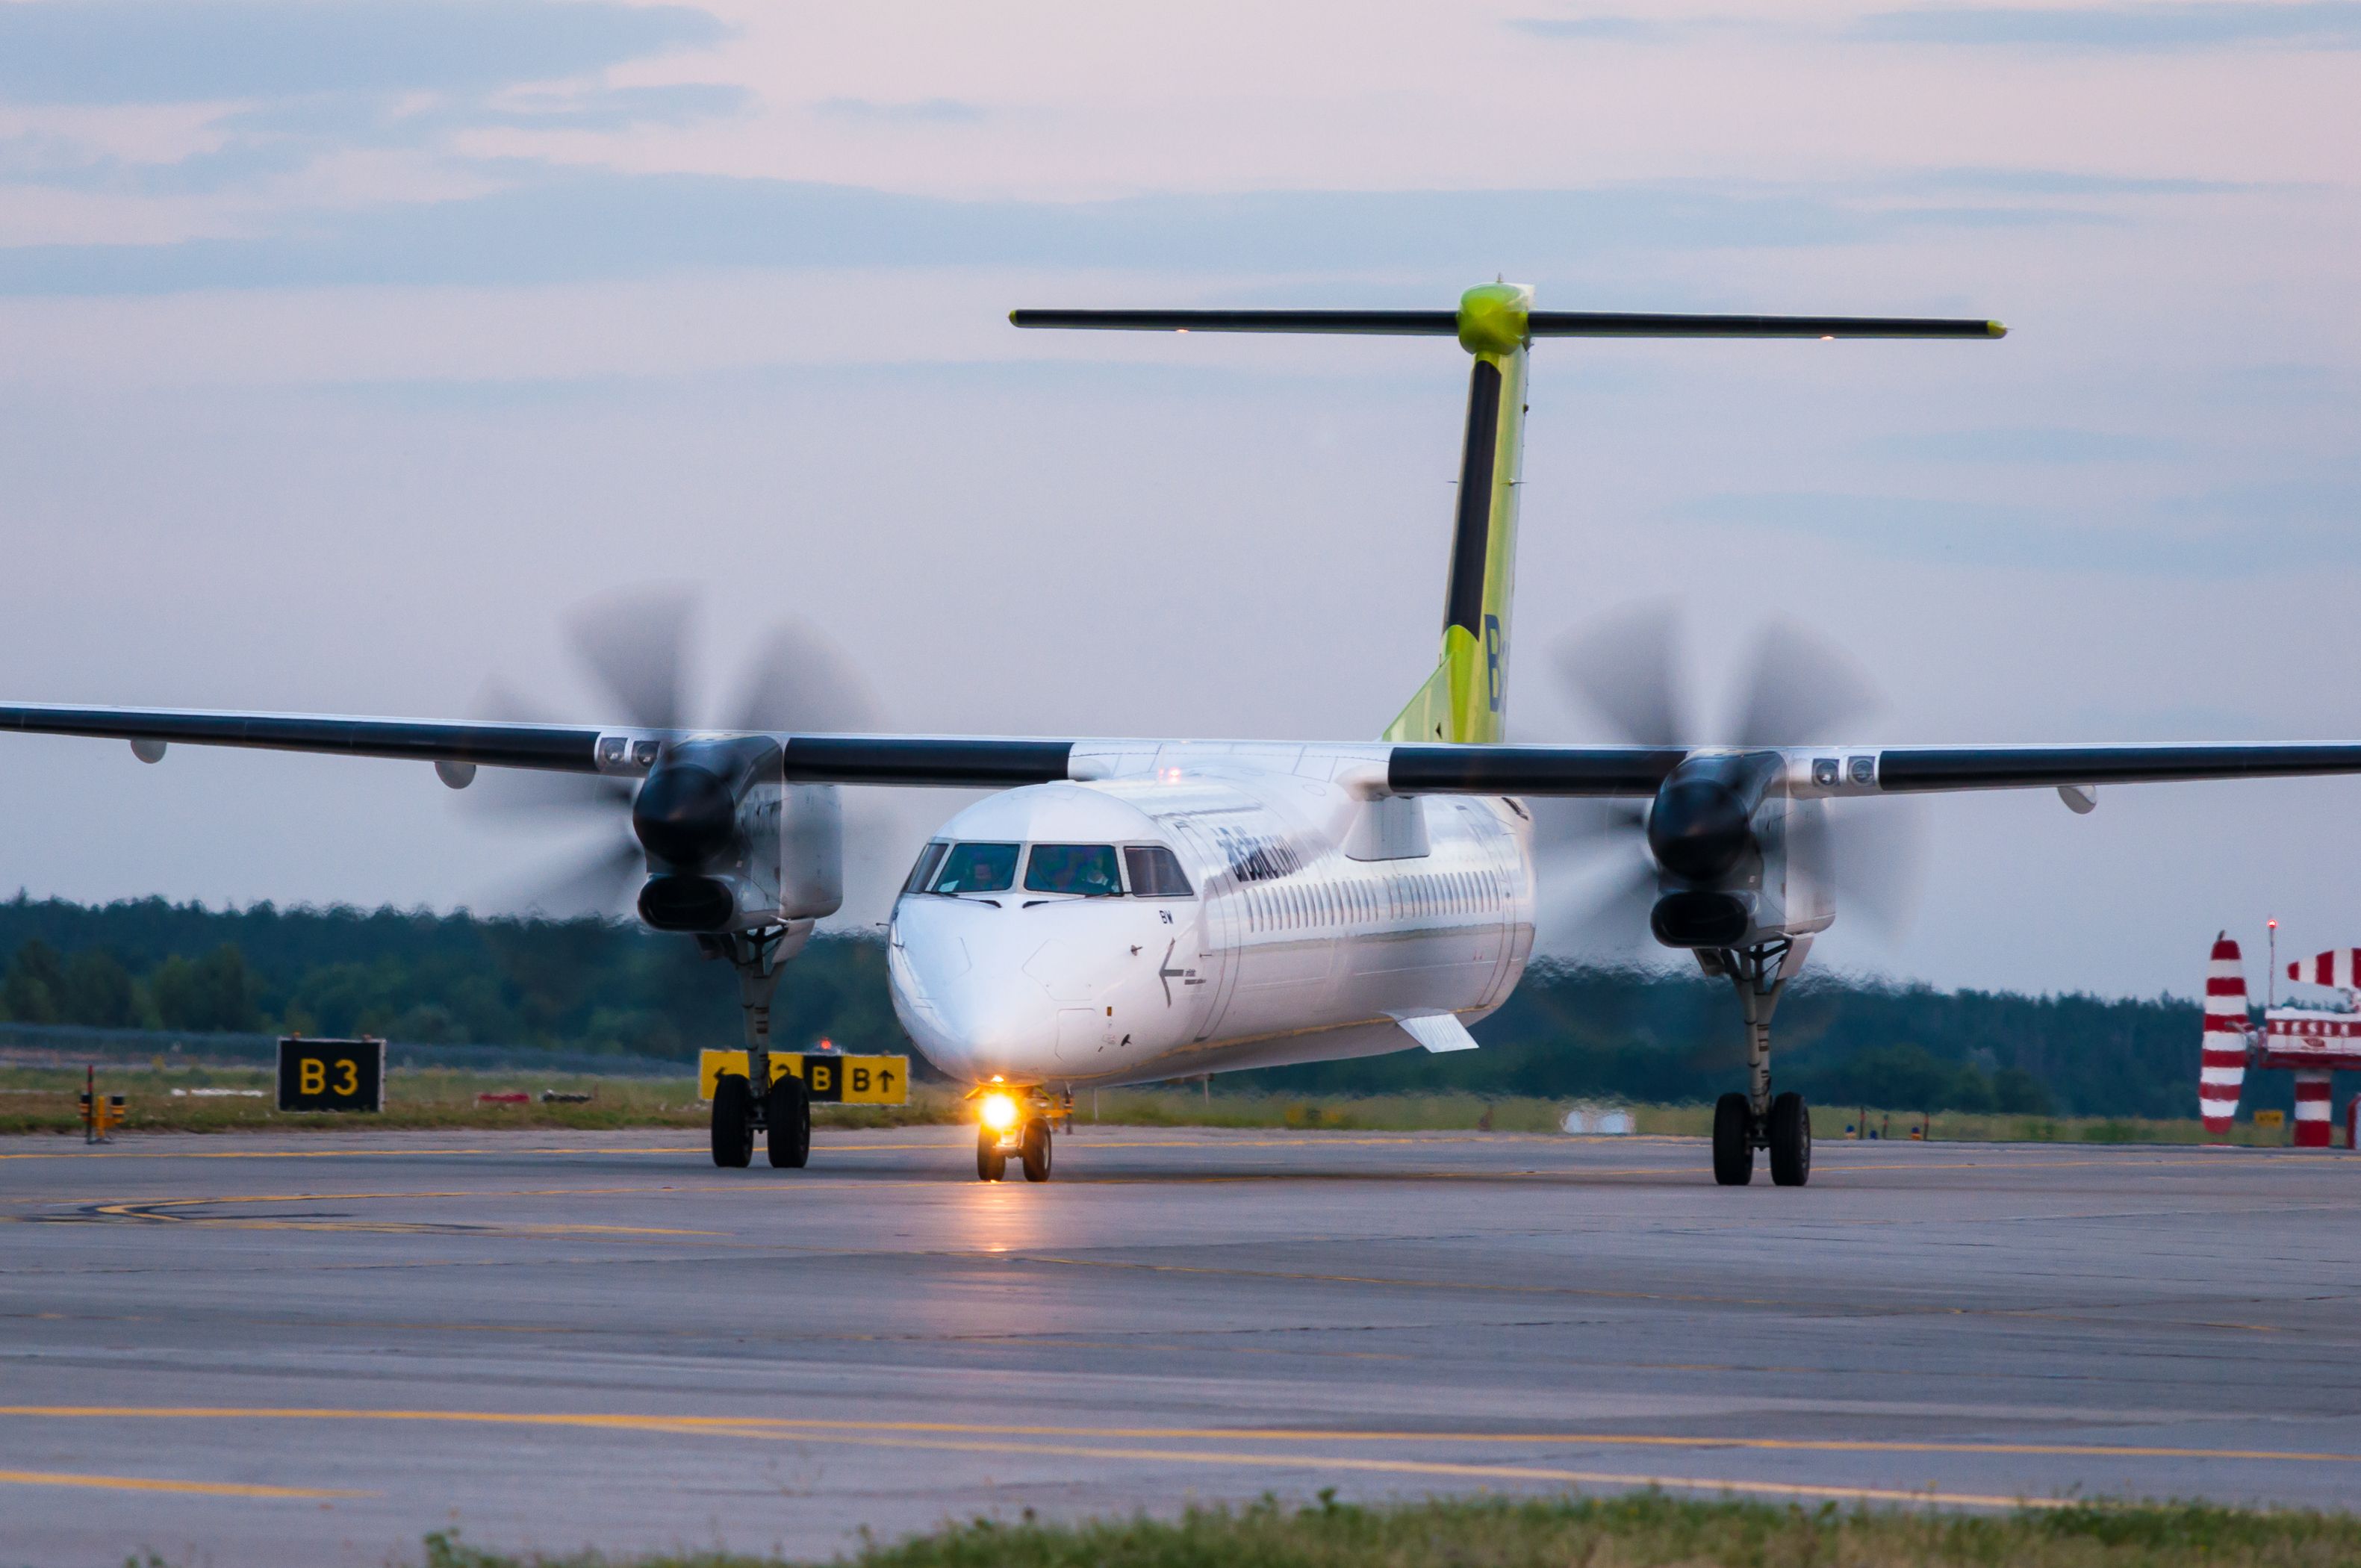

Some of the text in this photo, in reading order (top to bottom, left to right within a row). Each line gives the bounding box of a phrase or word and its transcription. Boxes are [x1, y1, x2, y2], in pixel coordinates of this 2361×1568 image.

[300, 1058, 358, 1096] B3
[812, 1065, 831, 1091] B
[853, 1068, 870, 1092] B
